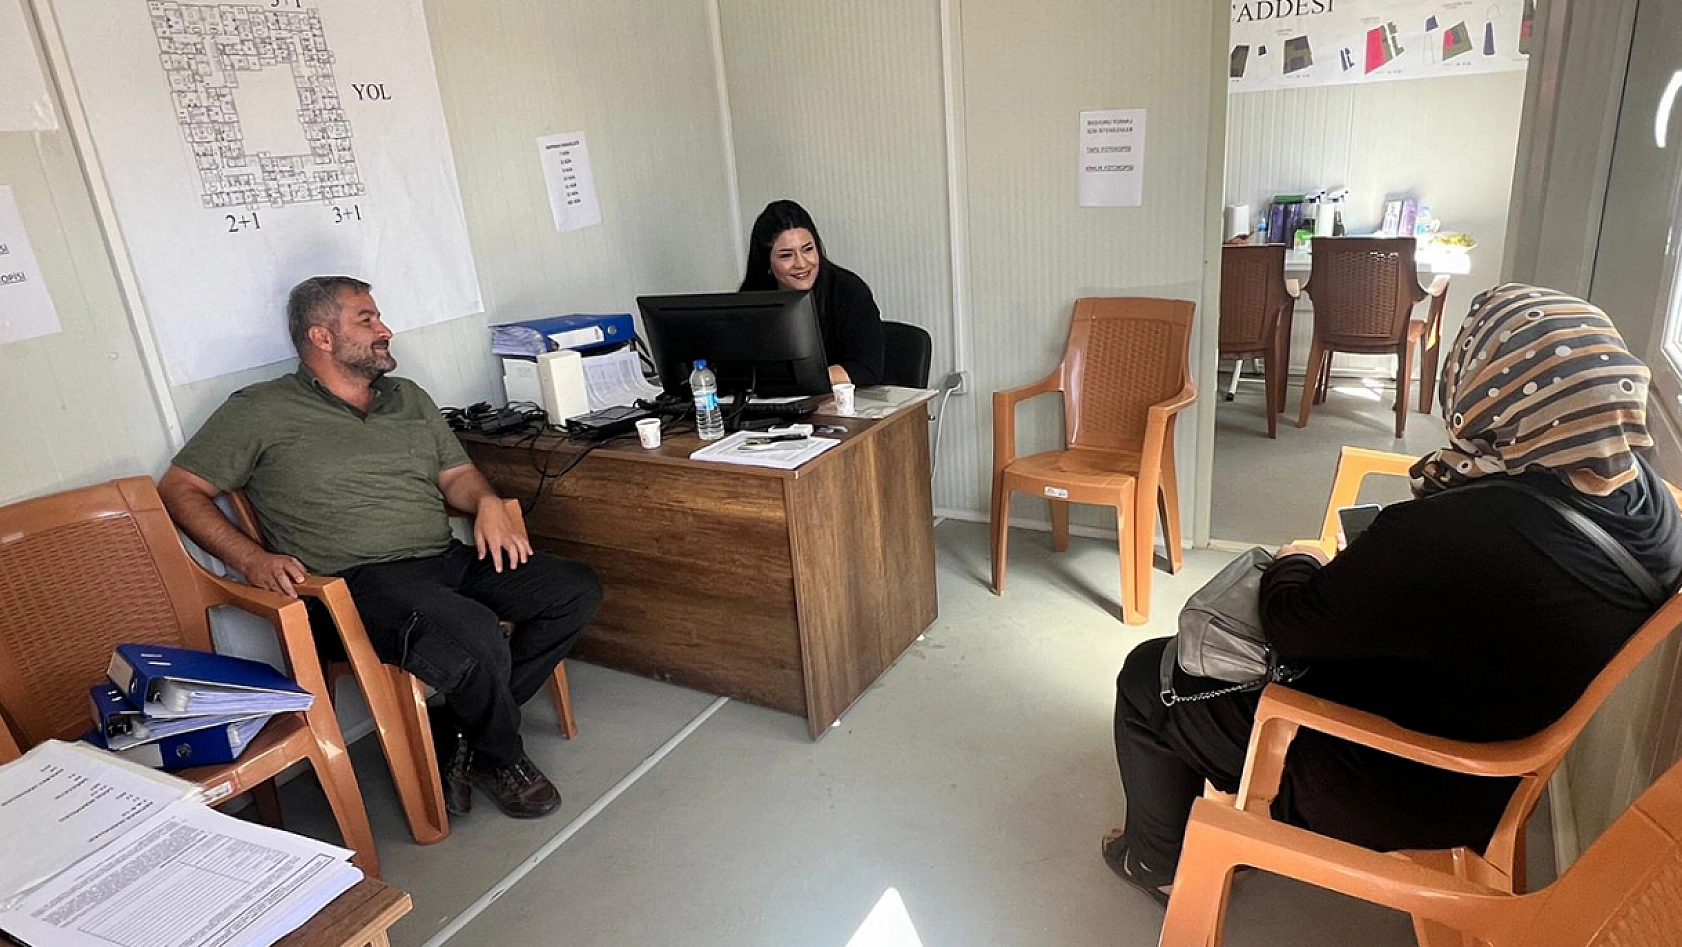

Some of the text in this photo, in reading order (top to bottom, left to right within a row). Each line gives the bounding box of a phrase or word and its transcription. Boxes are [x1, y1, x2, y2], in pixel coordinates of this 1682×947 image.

[351, 83, 392, 101] YOL
[226, 212, 261, 233] 2+1
[332, 205, 362, 224] 3+1
